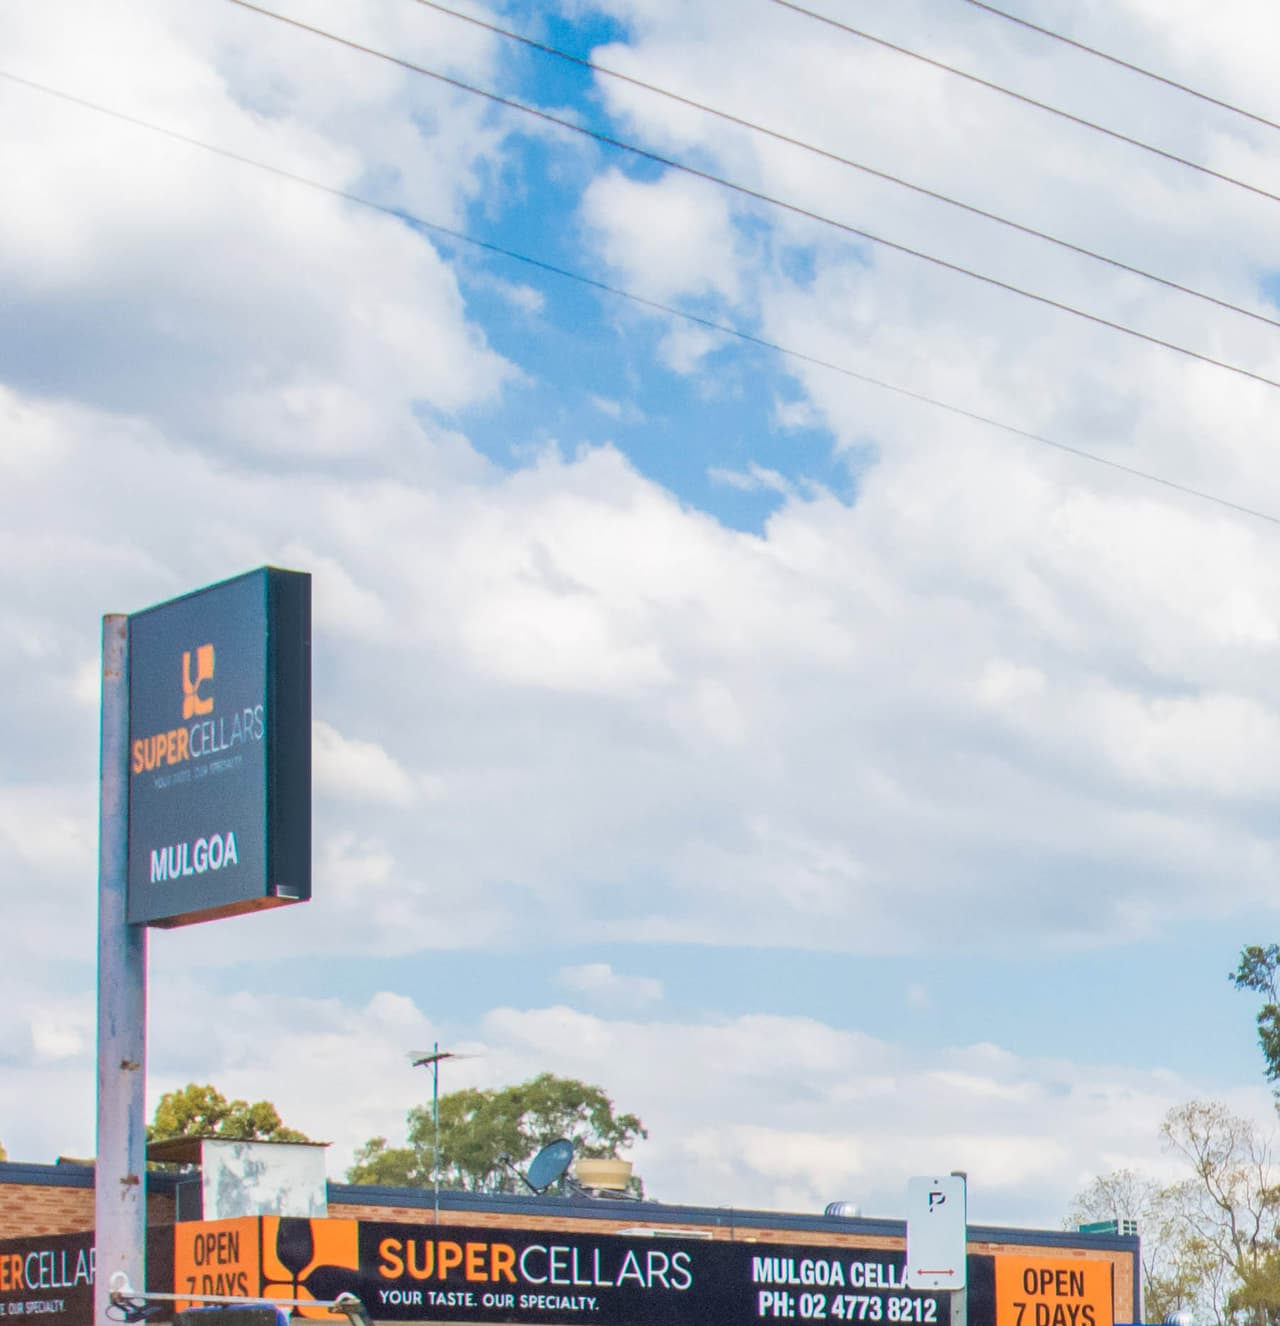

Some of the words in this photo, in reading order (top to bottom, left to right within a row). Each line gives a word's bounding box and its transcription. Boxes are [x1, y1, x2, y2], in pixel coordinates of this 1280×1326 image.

[133, 705, 264, 774] SUPERCELLARS
[150, 831, 239, 883] MULGOA
[194, 1231, 240, 1266] OPEN
[378, 1238, 692, 1290] SUPERCELLARS
[752, 1256, 845, 1287] MULGOA
[1023, 1268, 1084, 1297] OPEN
[379, 1290, 422, 1305] YOUR
[428, 1291, 478, 1307] TASTE.
[483, 1293, 514, 1308] OUR
[520, 1294, 599, 1311] SPECIALTY.
[758, 1291, 795, 1318] PH:
[799, 1293, 826, 1319] 02
[831, 1294, 883, 1320] 4773
[887, 1297, 938, 1323] 8212
